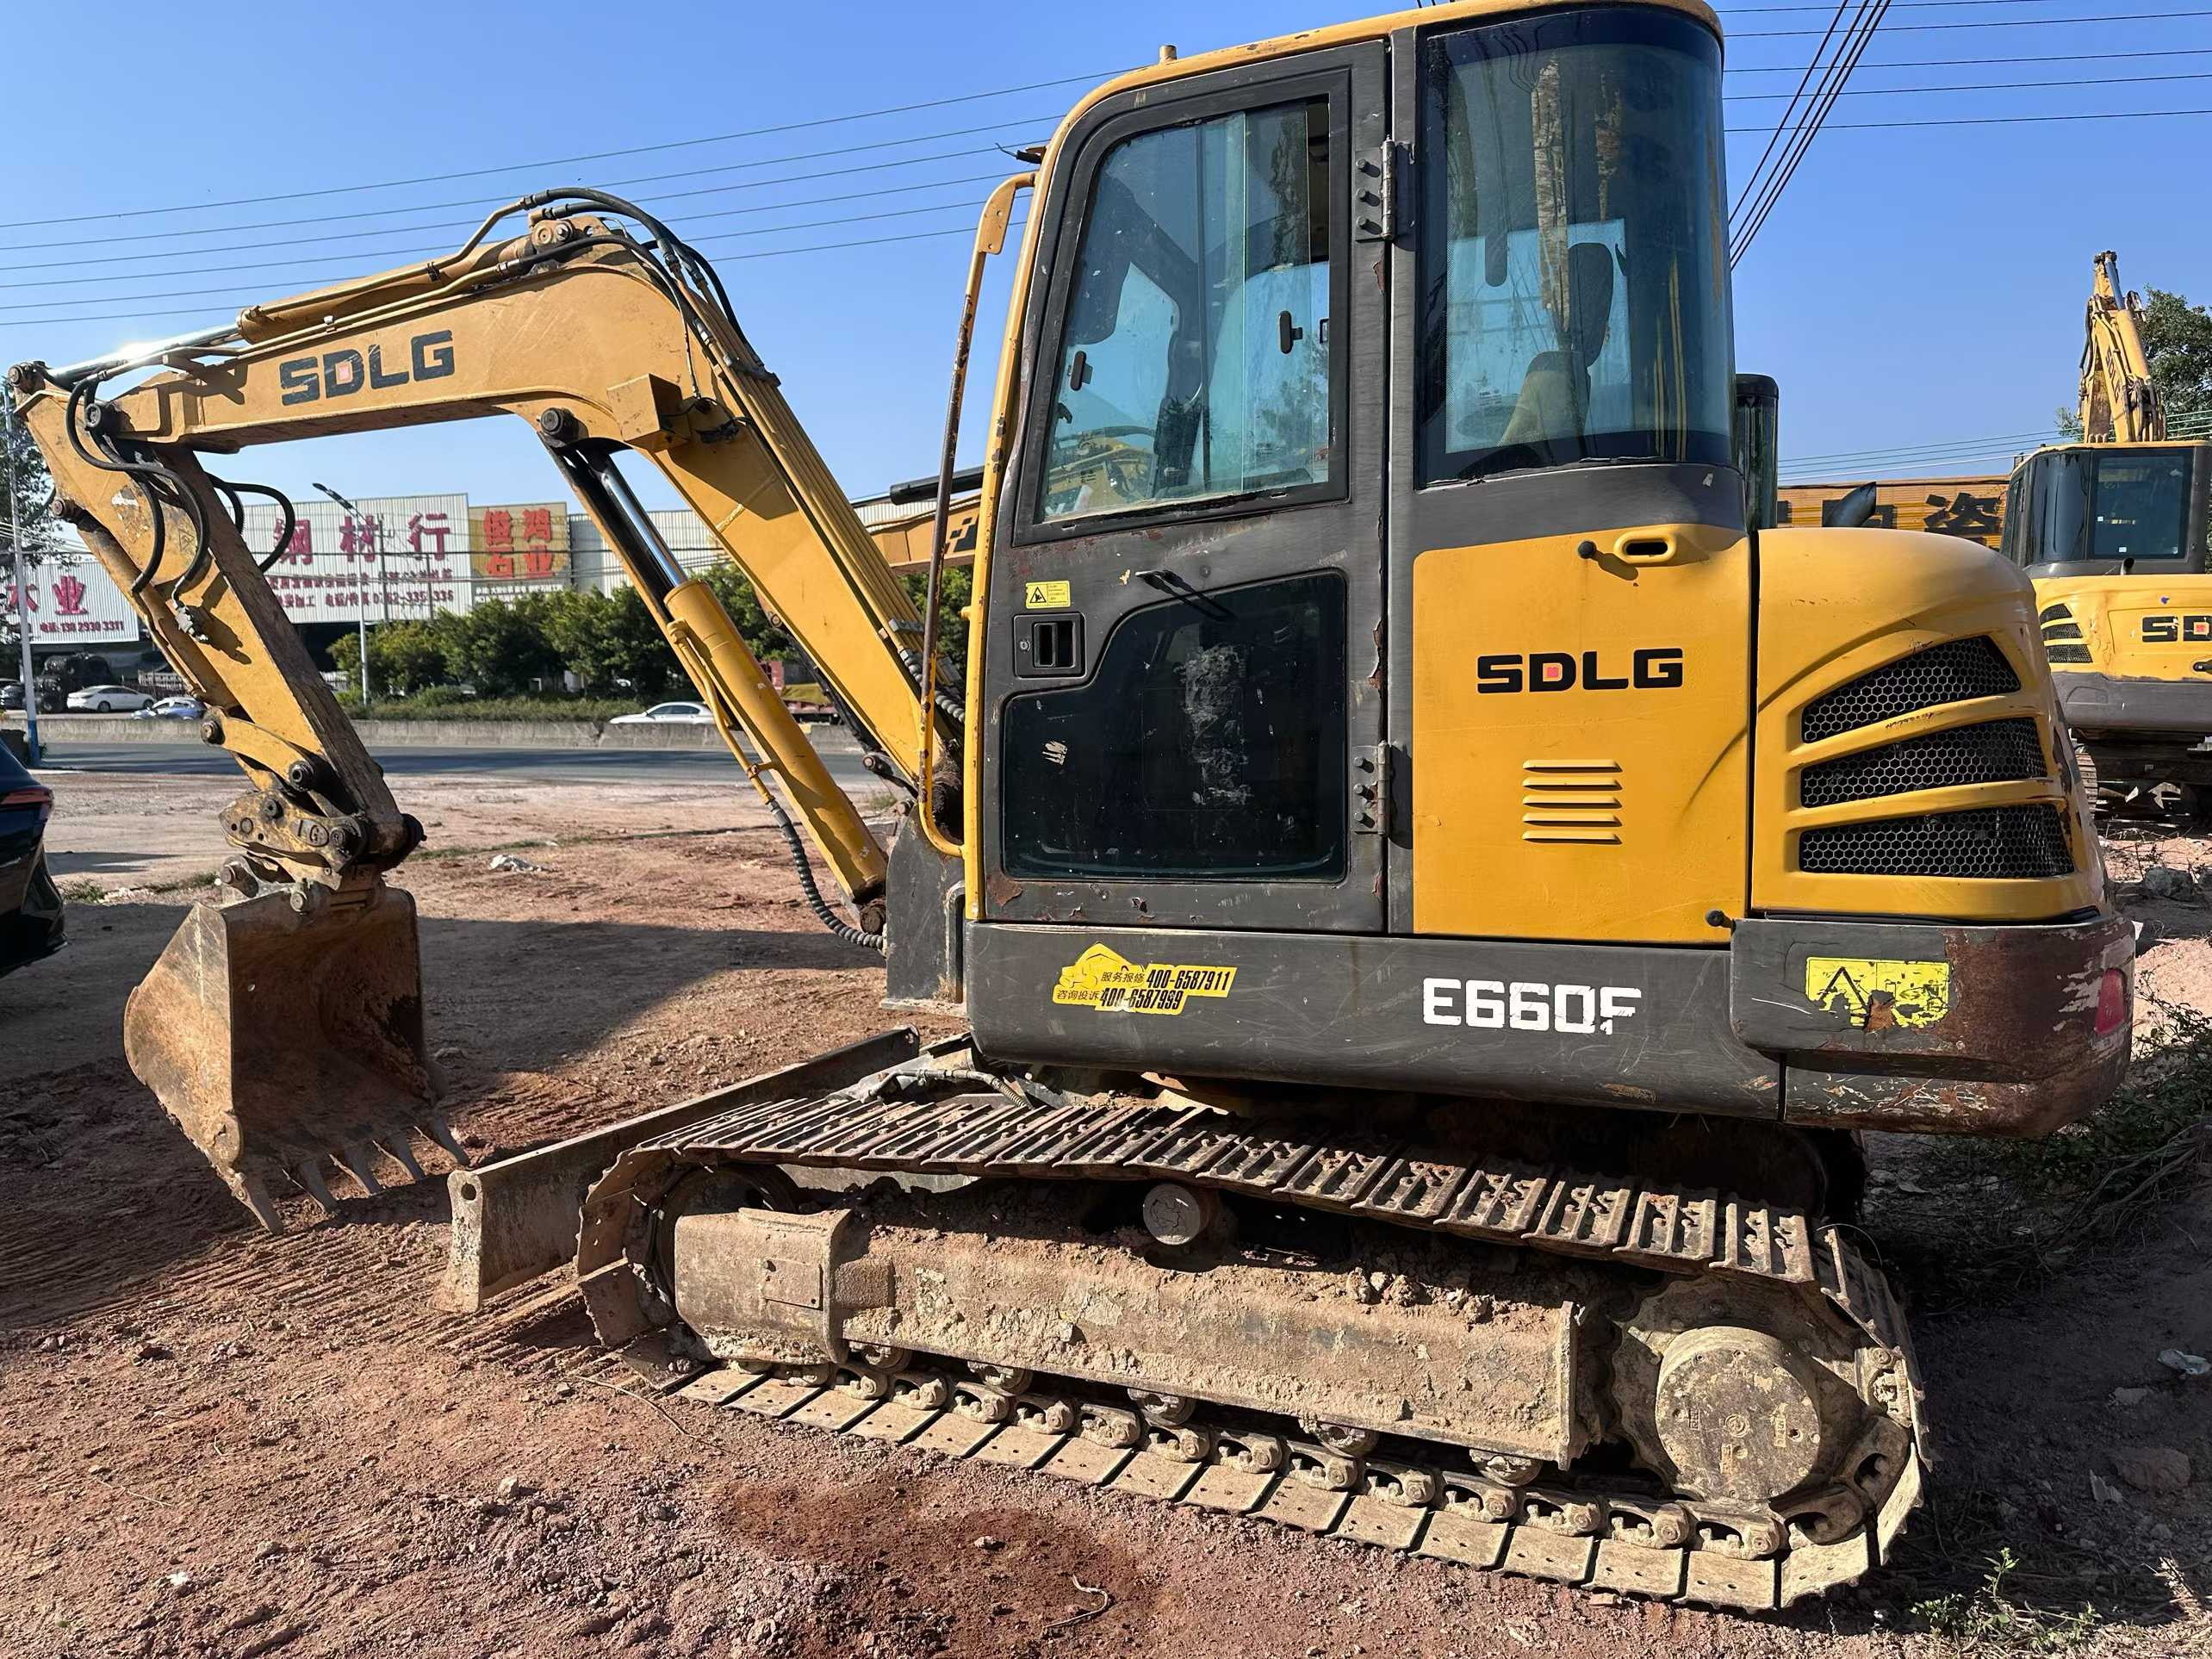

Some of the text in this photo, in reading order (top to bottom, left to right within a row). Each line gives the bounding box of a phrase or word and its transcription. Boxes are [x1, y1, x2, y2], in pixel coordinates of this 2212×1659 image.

[279, 330, 456, 406] SDLG
[486, 544, 554, 579] 石业
[1476, 648, 1684, 694] SDLG
[1056, 987, 1184, 1010] 咨询投诉 400-6587999
[1101, 969, 1232, 991] 服务报修 400-6587911
[1423, 978, 1642, 1035] E660F
